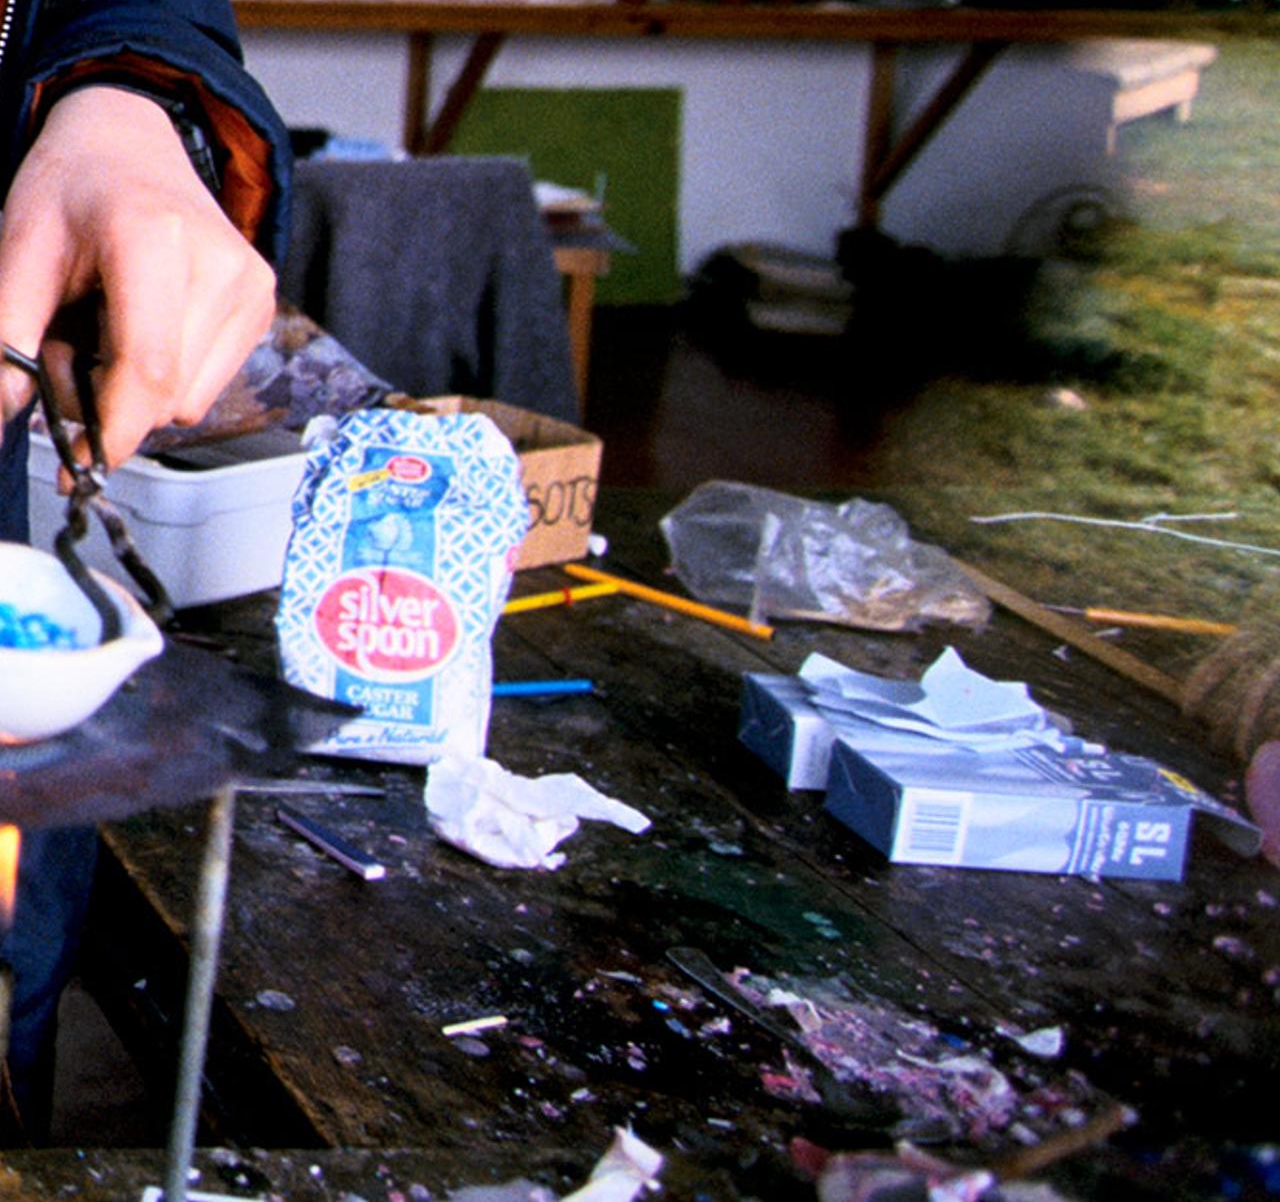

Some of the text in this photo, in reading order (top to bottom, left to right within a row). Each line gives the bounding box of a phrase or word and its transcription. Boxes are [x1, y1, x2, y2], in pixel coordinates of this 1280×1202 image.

[338, 582, 439, 628] silver
[336, 620, 440, 662] spoon
[346, 684, 419, 706] CASTER
